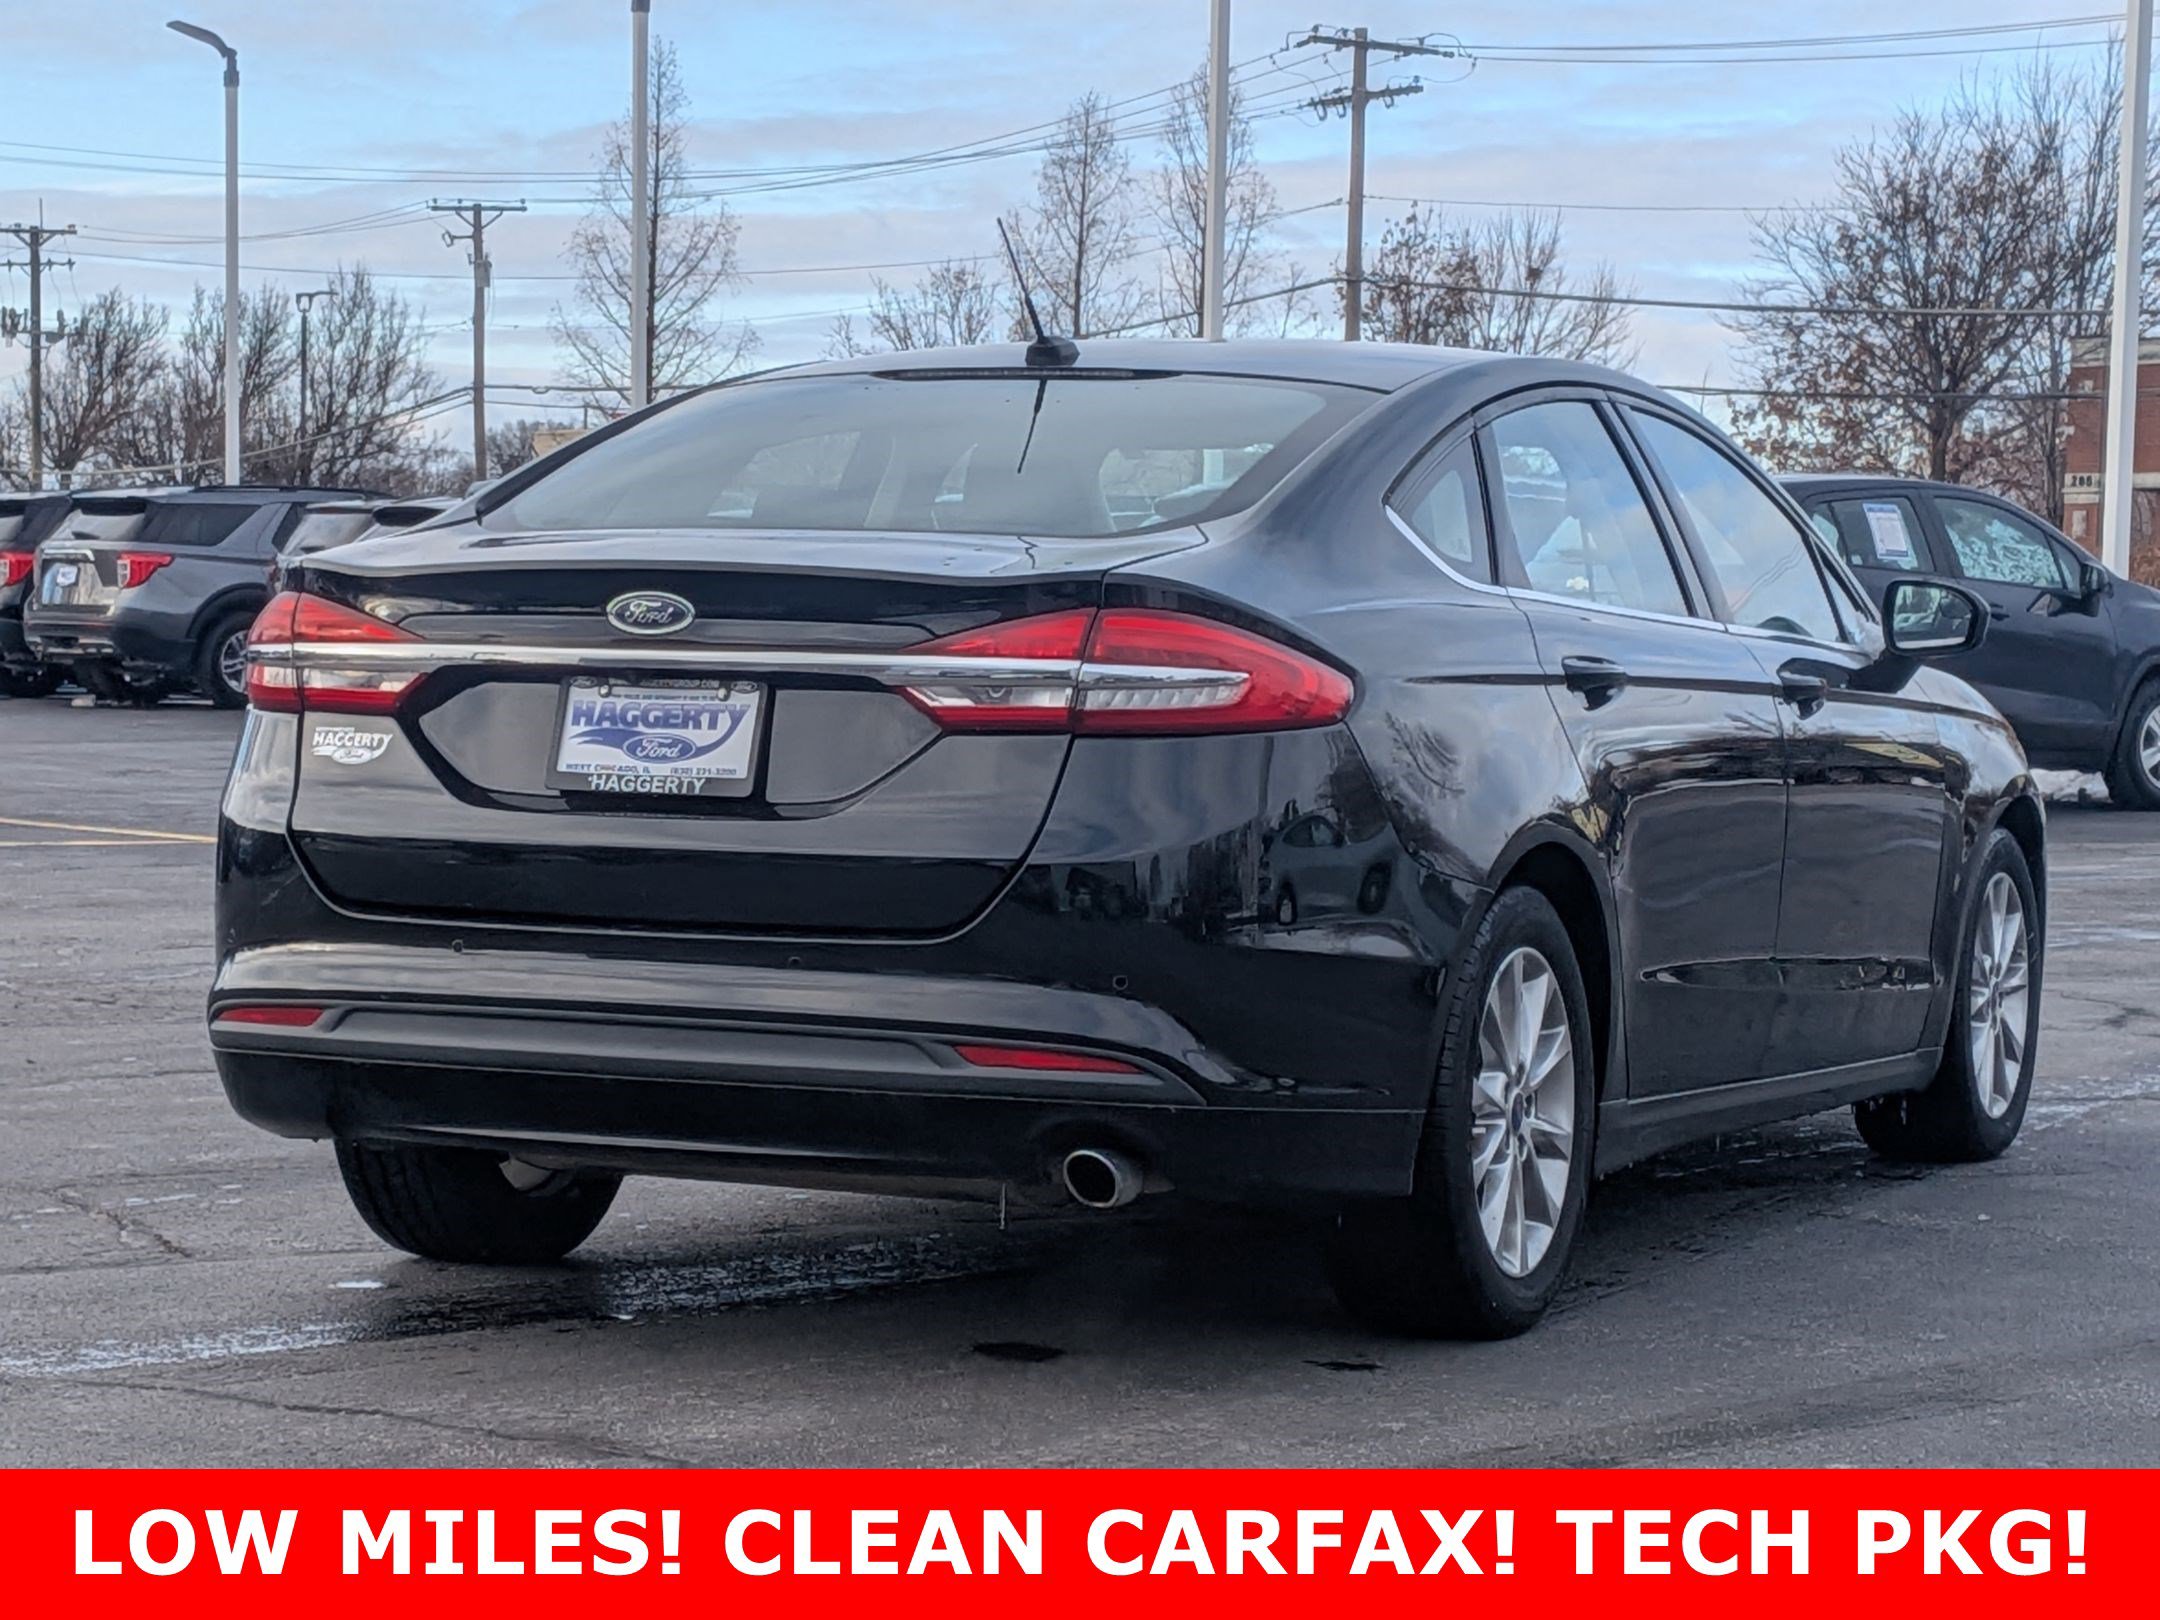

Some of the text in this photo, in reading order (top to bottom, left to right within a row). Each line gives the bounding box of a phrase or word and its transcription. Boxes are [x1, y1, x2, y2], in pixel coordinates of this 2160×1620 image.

[624, 600, 675, 623] Ford
[570, 699, 751, 731] HAGGERTY
[312, 731, 393, 748] HAGGERTY
[636, 738, 681, 759] Ford
[591, 774, 706, 795] HAGGERTY
